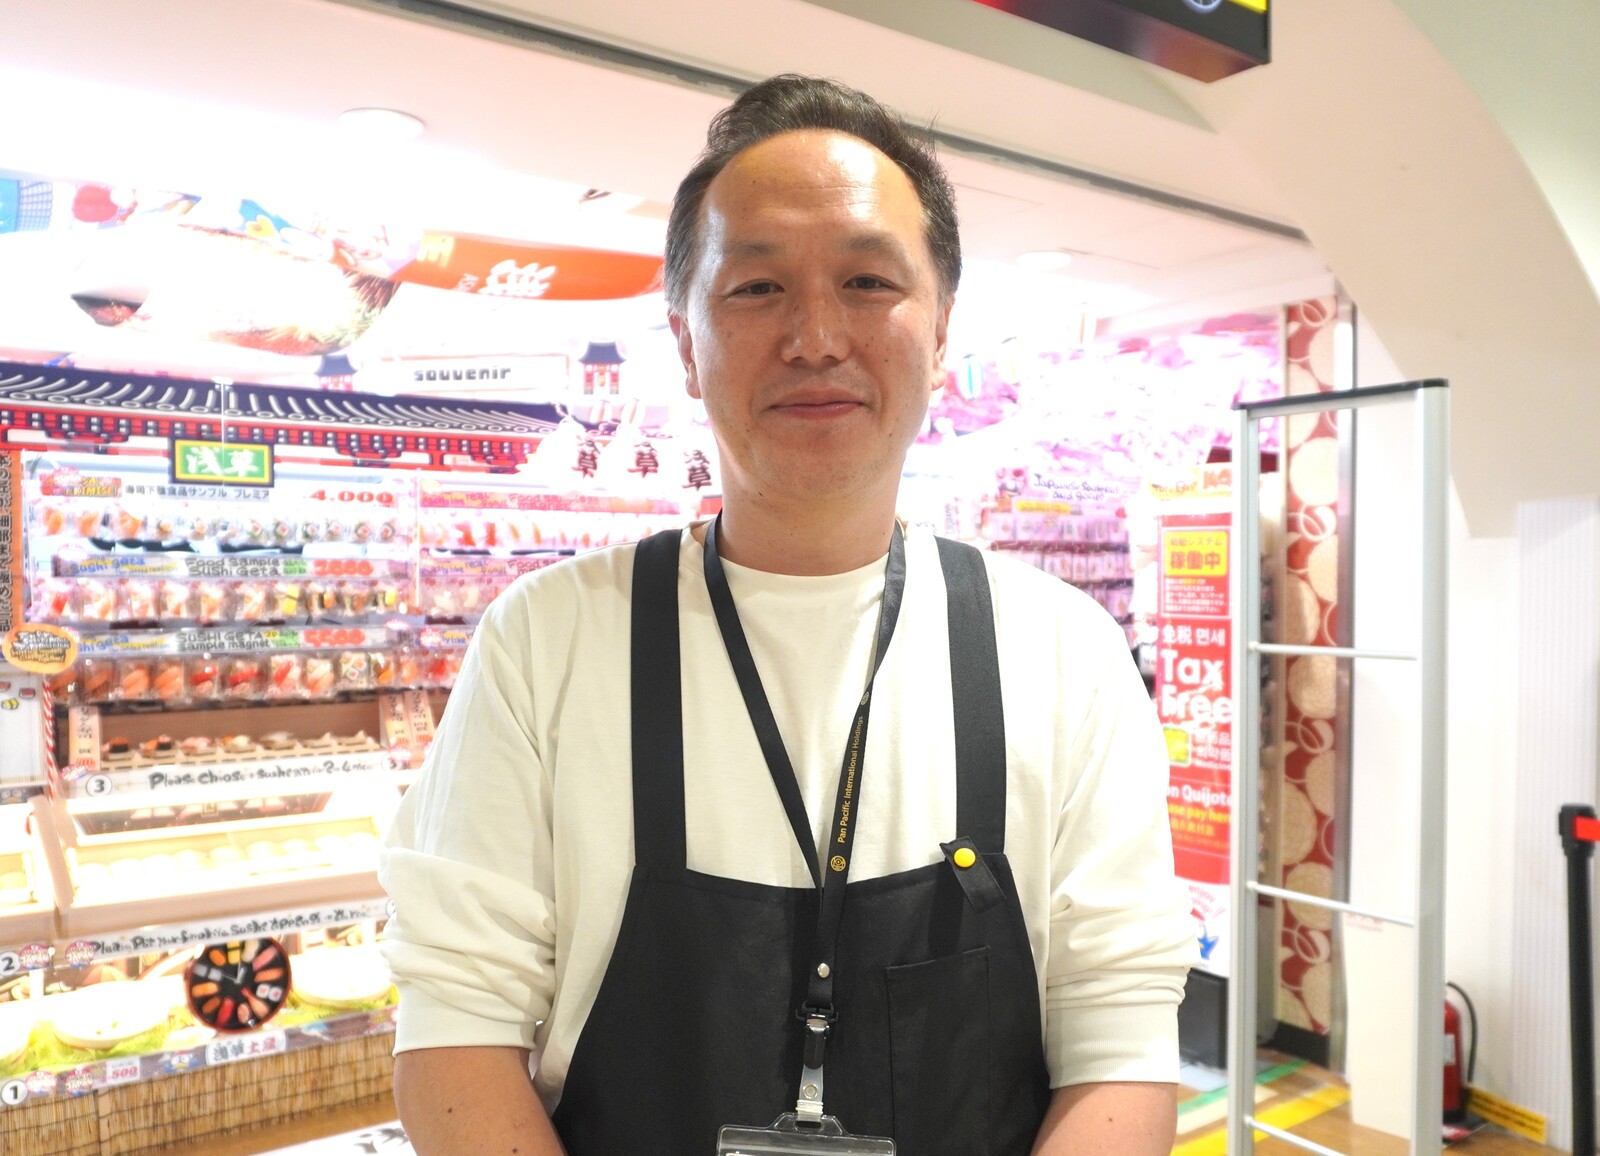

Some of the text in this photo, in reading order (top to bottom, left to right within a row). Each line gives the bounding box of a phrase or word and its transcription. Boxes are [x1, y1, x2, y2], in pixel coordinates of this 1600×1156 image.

[414, 365, 511, 382] souvenir
[186, 445, 260, 477] 浅草
[184, 557, 226, 568] Food
[1160, 649, 1225, 688] Tax
[1161, 684, 1232, 723] Free
[92, 779, 105, 793] 3
[837, 716, 864, 844] Pan Pacific International Holdings
[2, 956, 15, 972] 2
[112, 1065, 138, 1079] 500
[9, 1084, 19, 1101] 1
